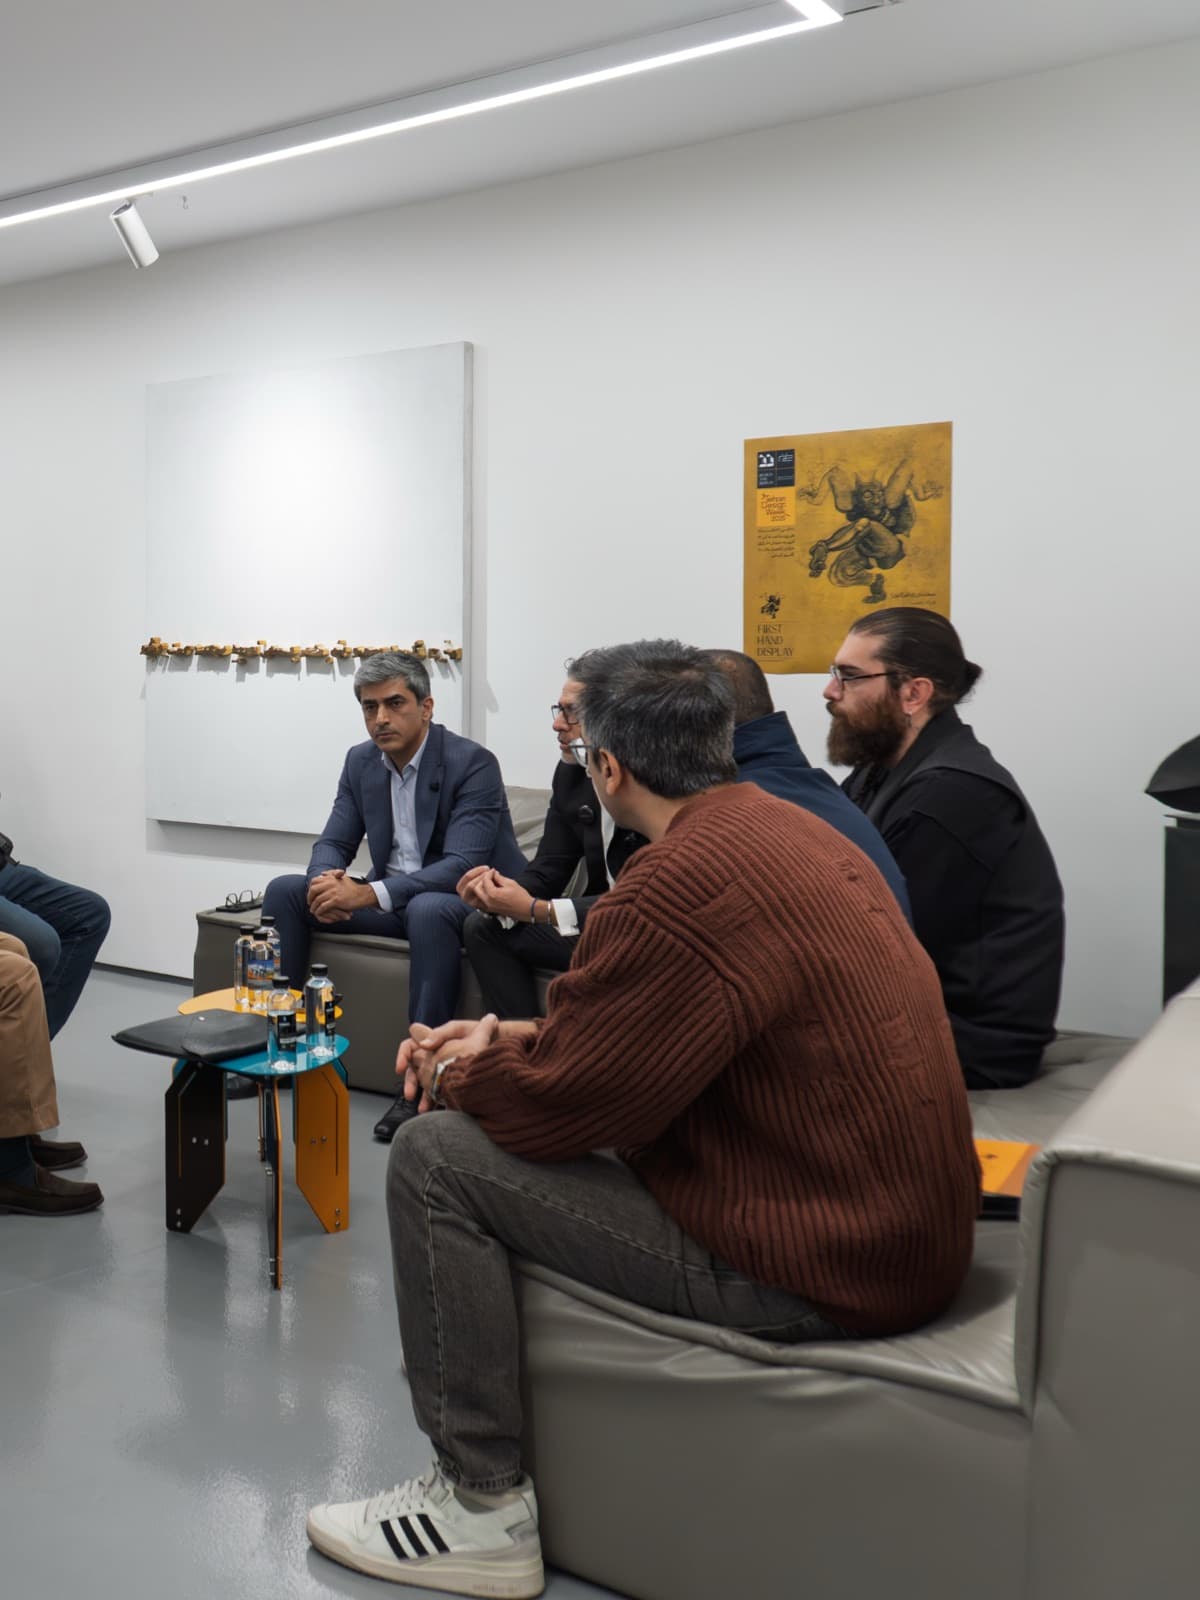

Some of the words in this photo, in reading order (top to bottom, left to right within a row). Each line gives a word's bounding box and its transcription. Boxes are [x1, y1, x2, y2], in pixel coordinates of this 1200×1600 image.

[757, 624, 782, 633] FIRST
[757, 636, 783, 645] HAND
[757, 648, 793, 657] DISPLAY
